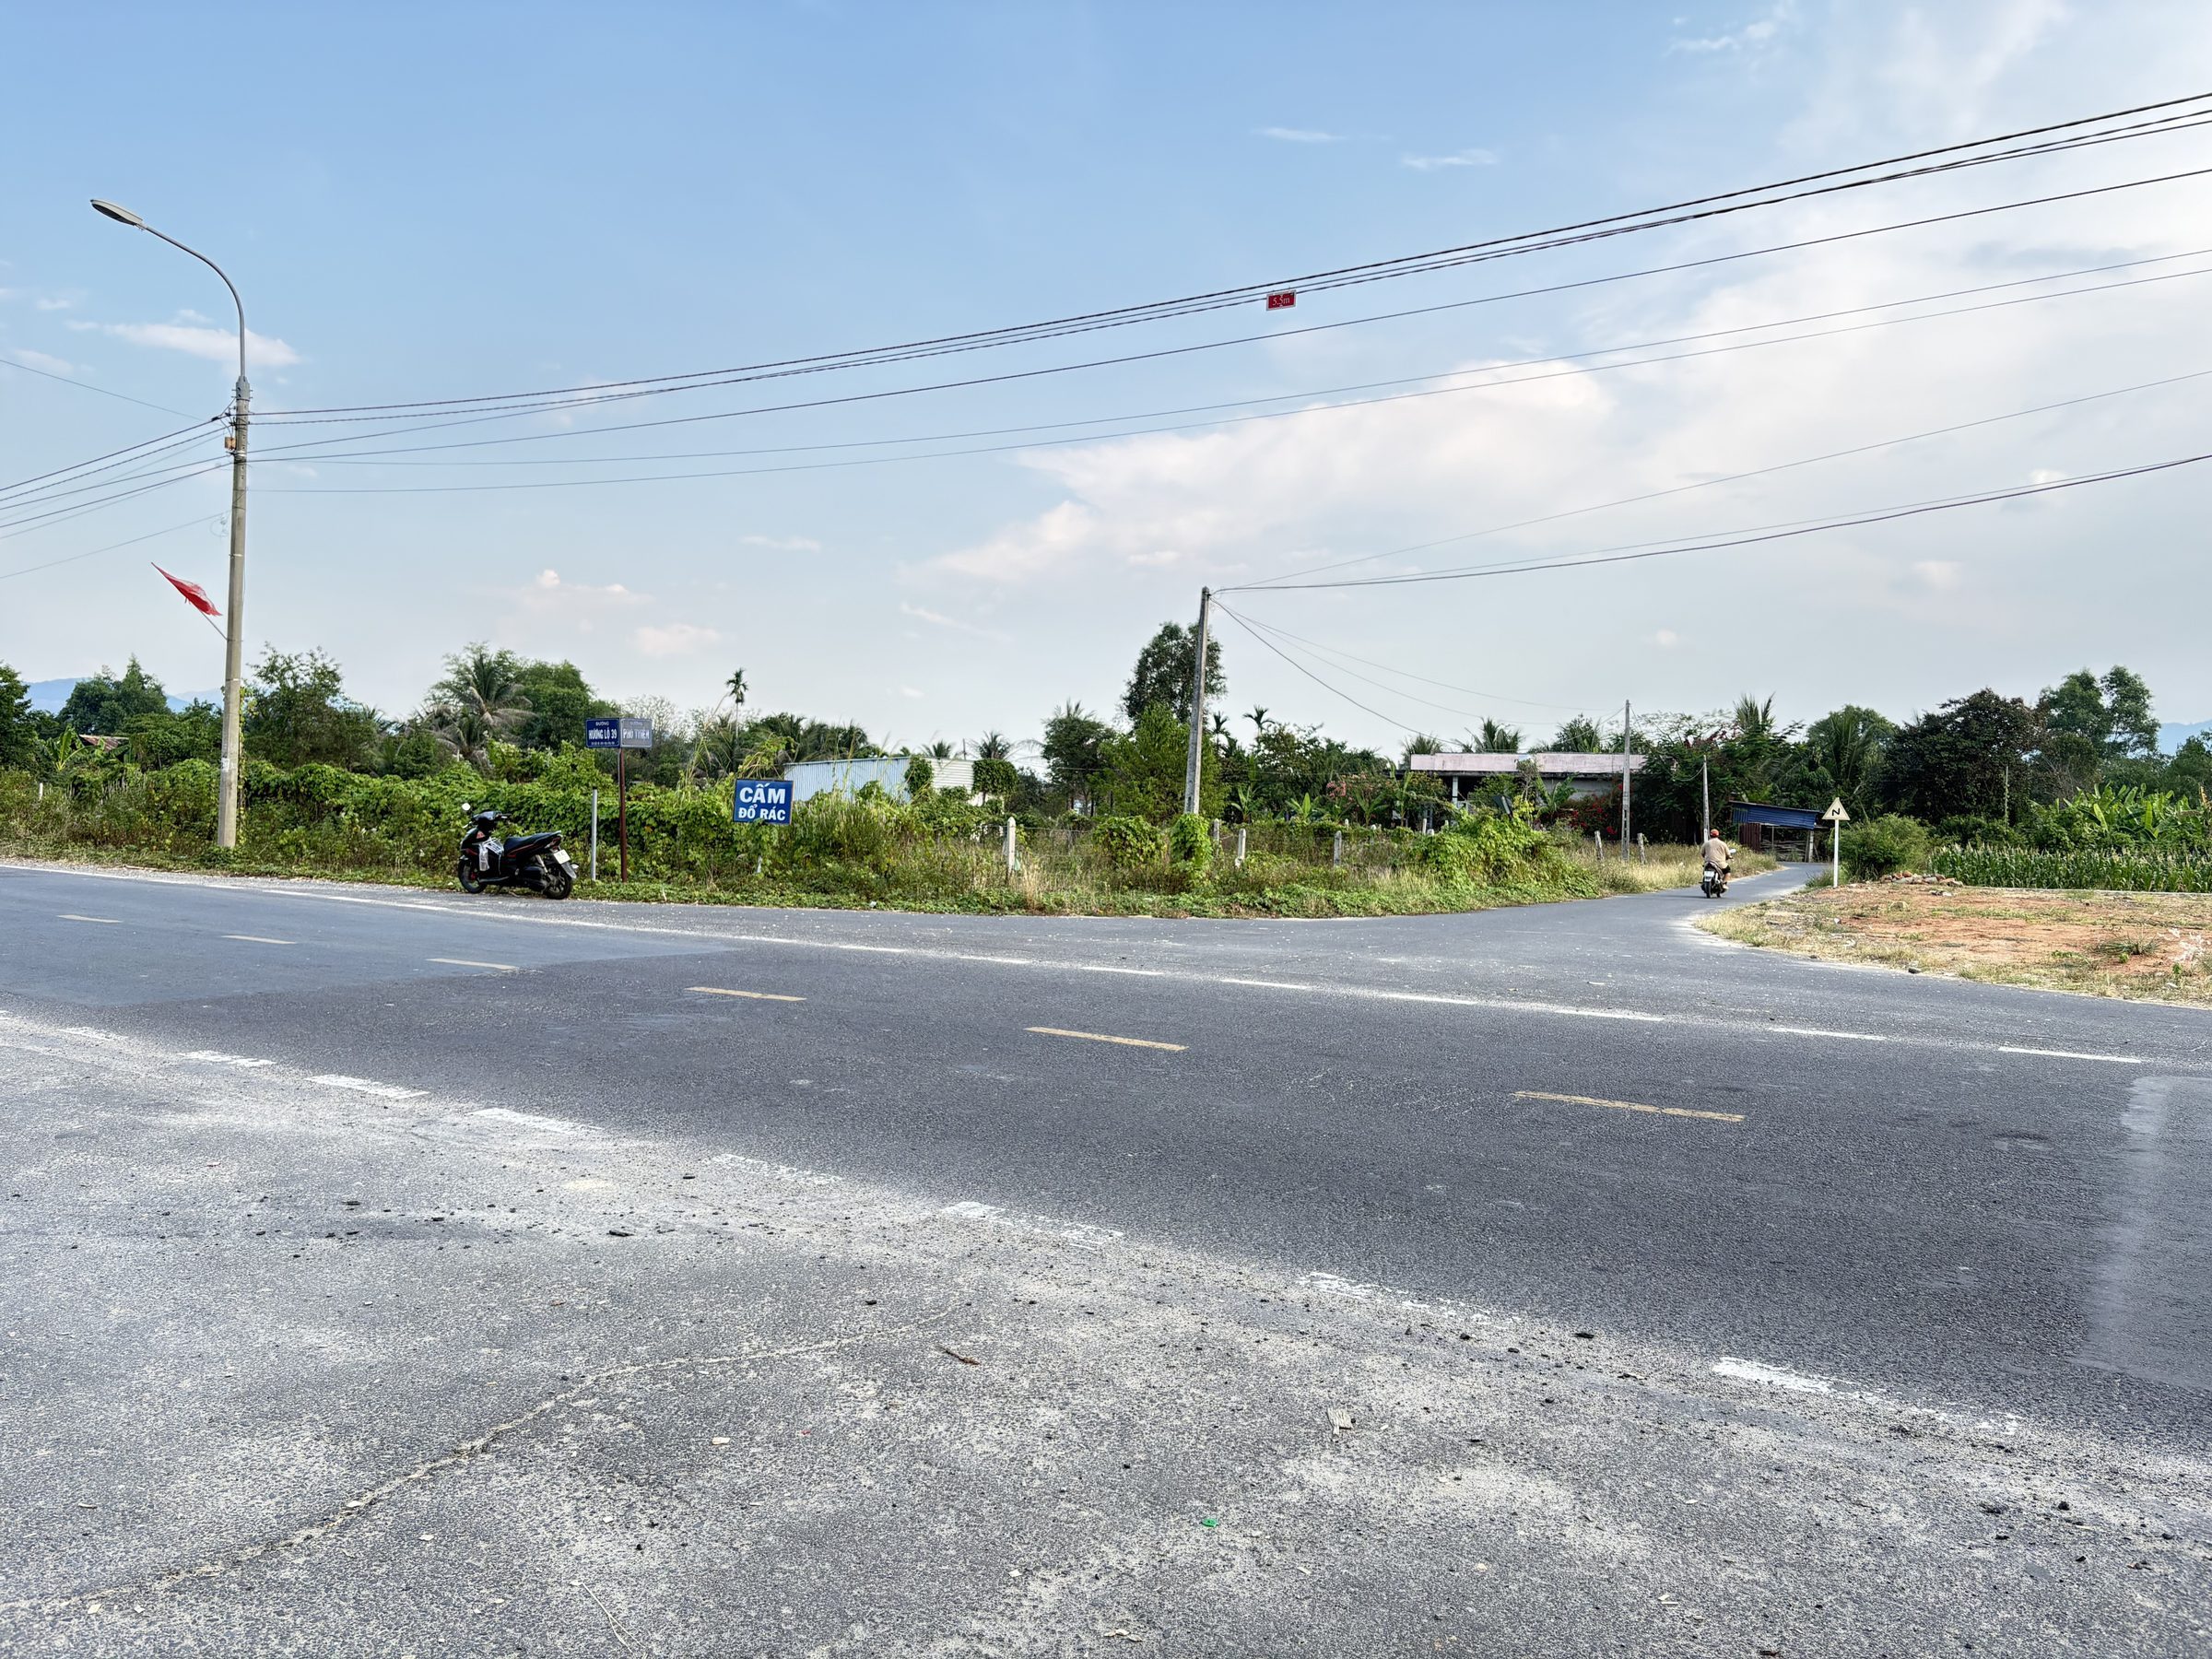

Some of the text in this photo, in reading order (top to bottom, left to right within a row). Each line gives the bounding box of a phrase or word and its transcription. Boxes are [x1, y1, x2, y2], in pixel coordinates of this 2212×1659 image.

[604, 726, 611, 740] LỘ
[611, 728, 618, 739] 39
[739, 782, 786, 805] CẤM
[738, 804, 786, 821] ĐỔ RÁC
